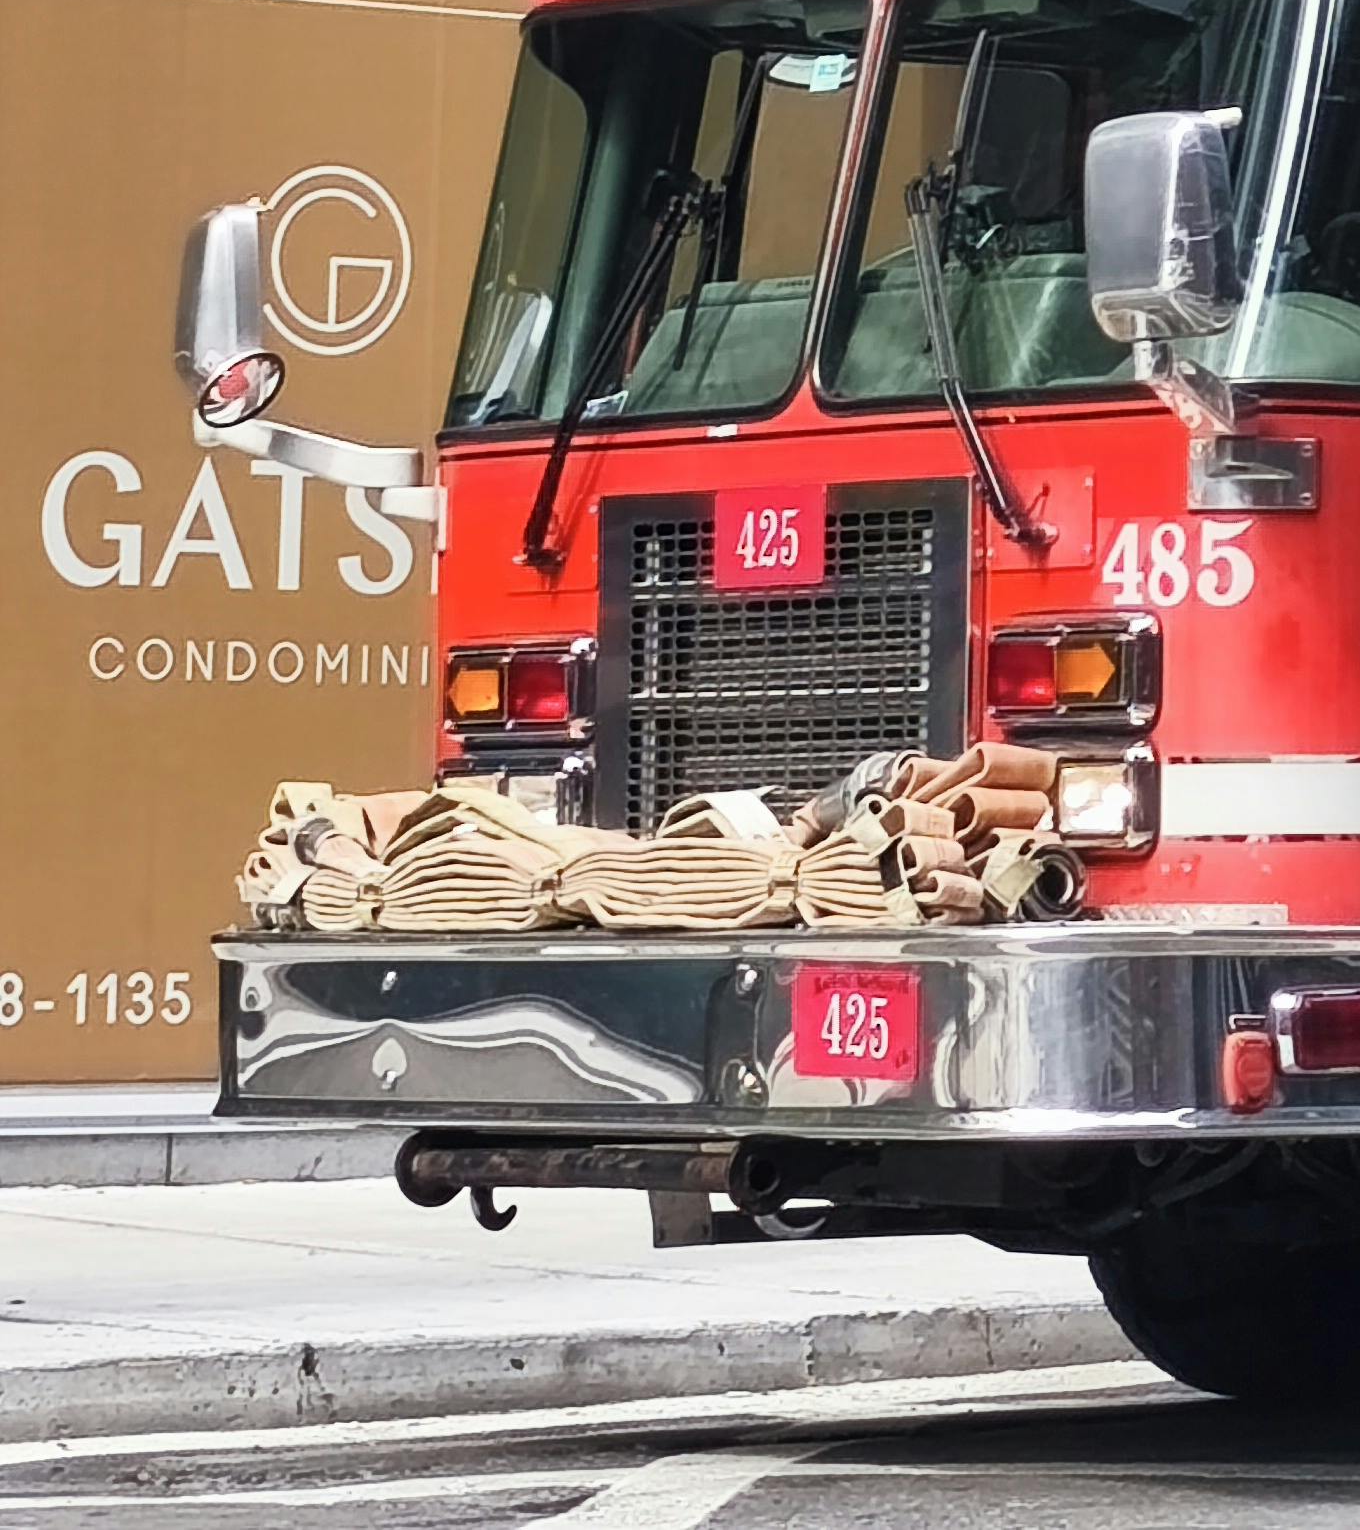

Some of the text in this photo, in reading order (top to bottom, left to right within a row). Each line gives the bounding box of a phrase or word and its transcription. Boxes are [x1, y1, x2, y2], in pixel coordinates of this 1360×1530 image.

[41, 450, 438, 596] GATS
[736, 508, 801, 570] 425
[1102, 517, 1256, 608] 485
[820, 993, 889, 1059] 425
